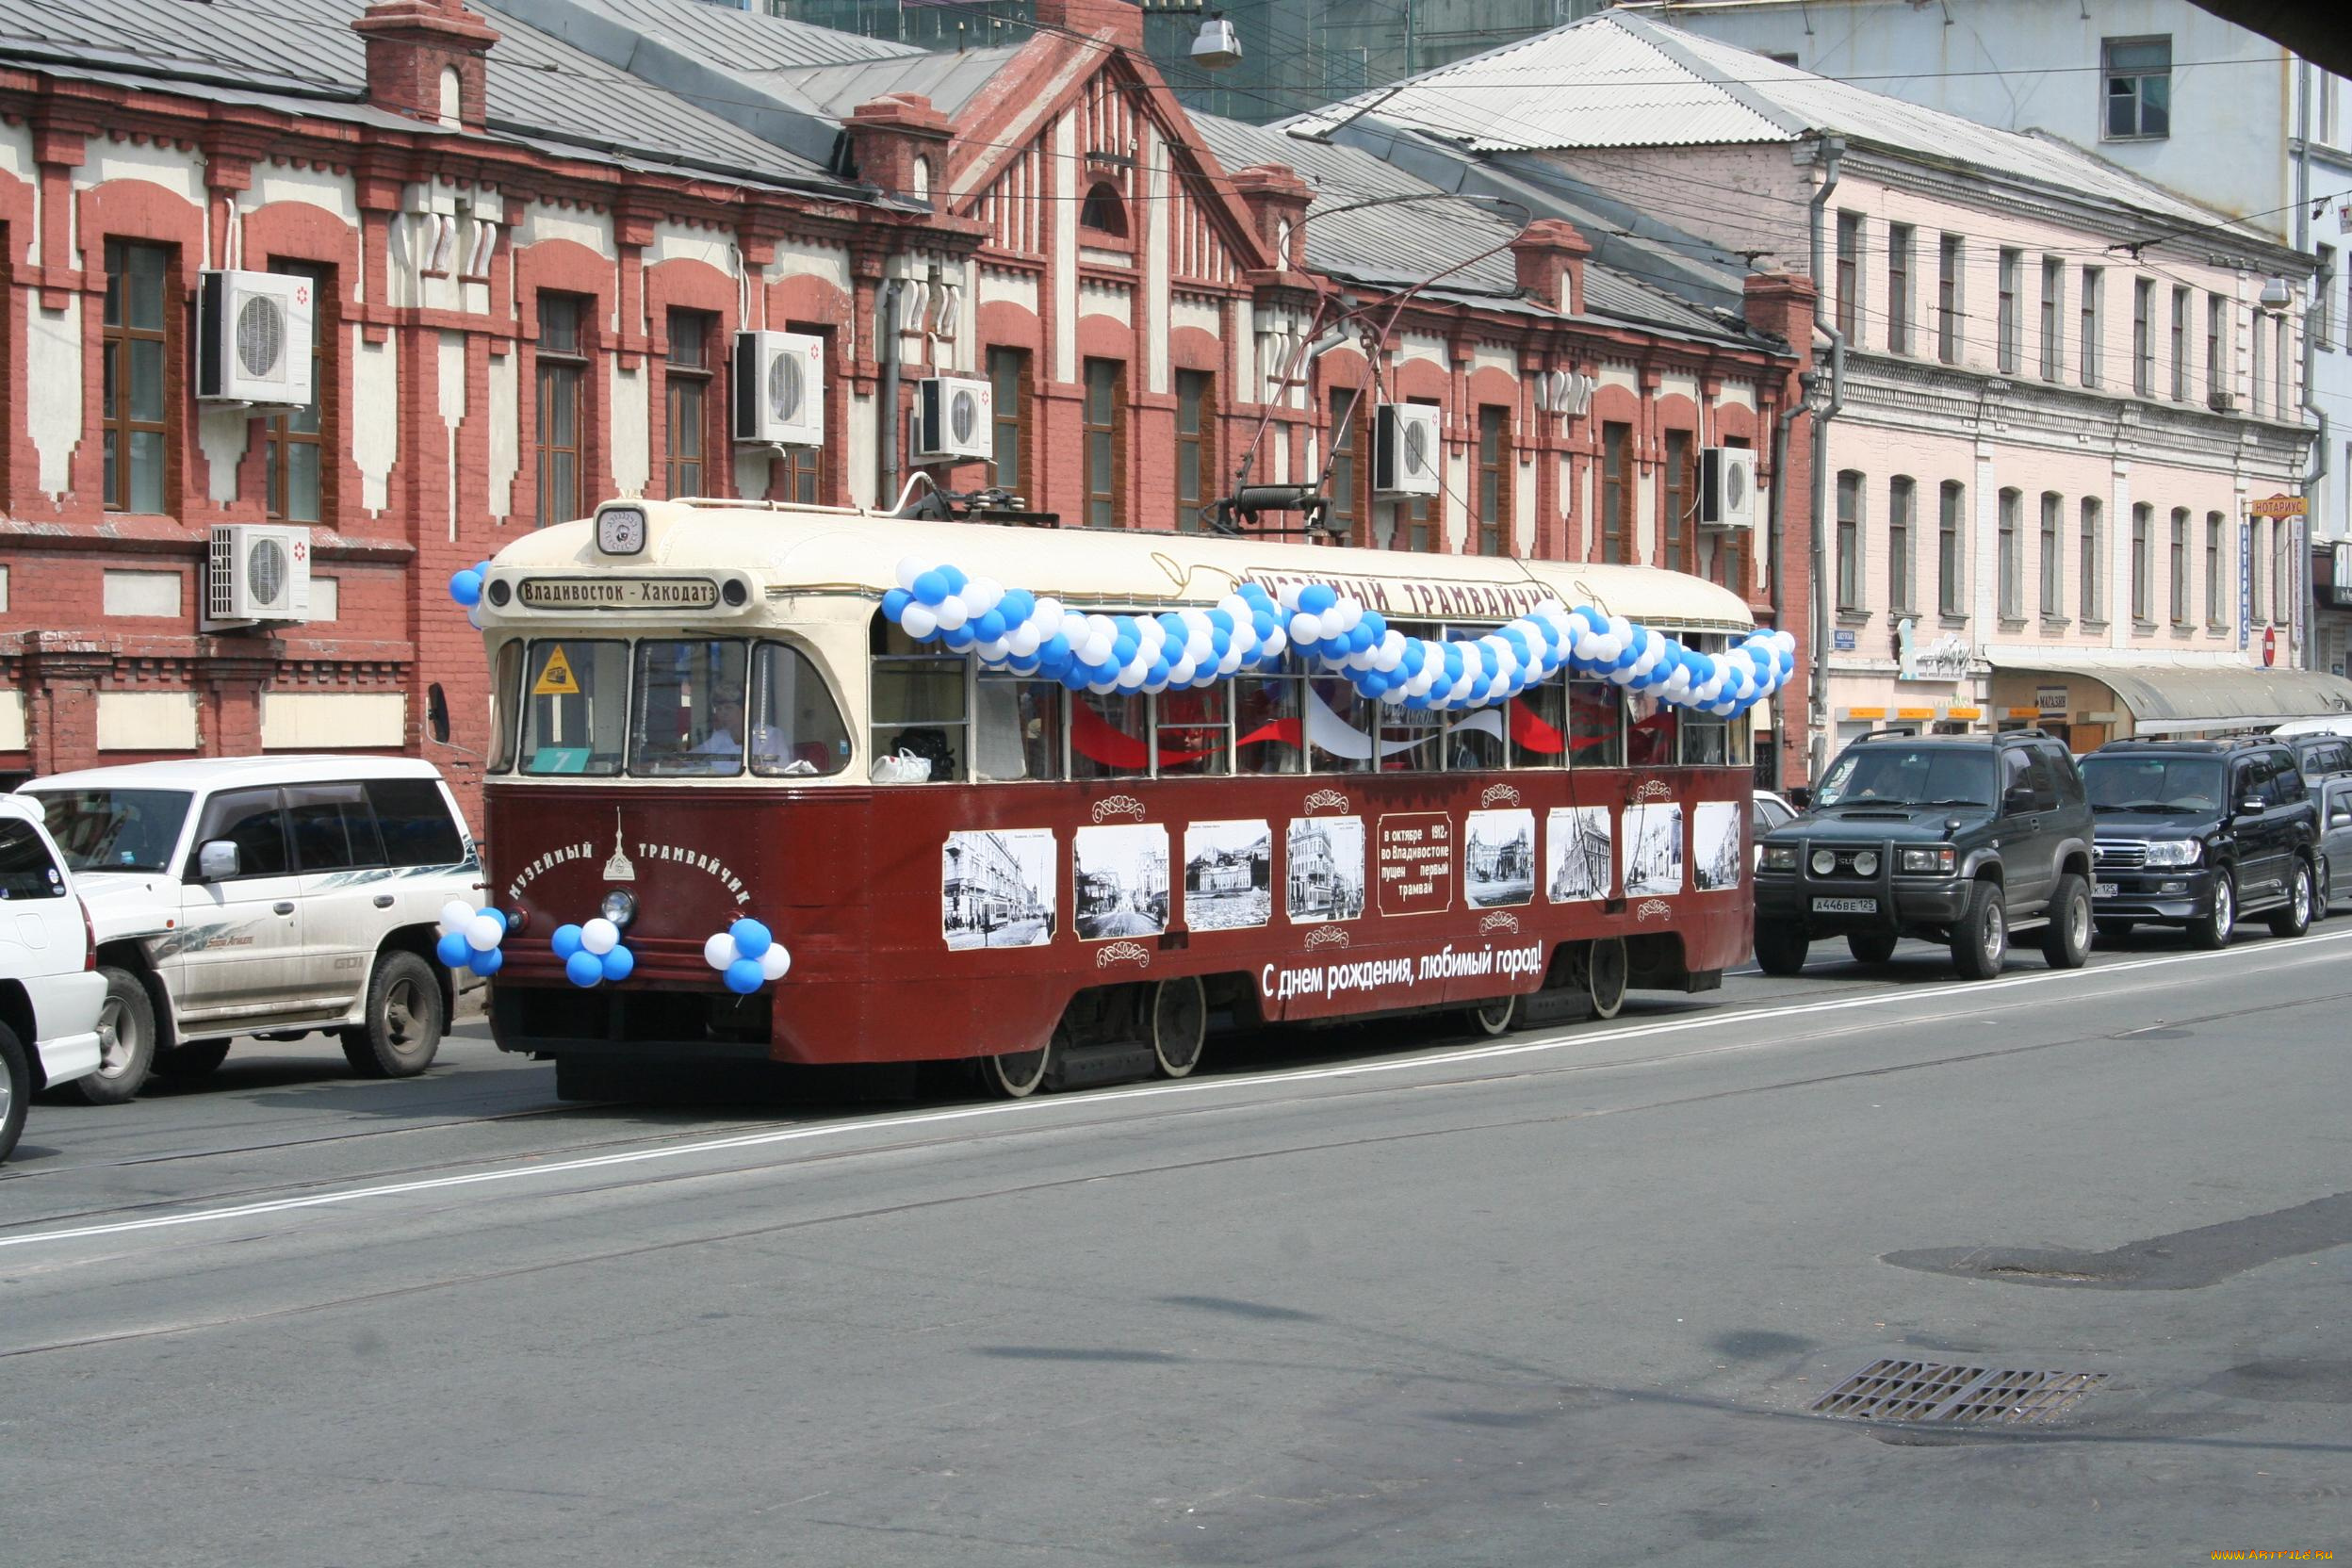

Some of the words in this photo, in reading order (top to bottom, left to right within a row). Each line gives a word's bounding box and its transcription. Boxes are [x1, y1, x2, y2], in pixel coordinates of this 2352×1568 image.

[2256, 501, 2302, 514] НОТАРИУС
[524, 582, 624, 601] Владивосток
[641, 585, 716, 602] Хакодатэ
[1384, 830, 1390, 842] в
[1392, 828, 1423, 845] октябре
[1380, 848, 1392, 860] во
[1392, 844, 1449, 862] Владивостоке
[508, 841, 593, 901] МУЗЕЙНЫЙ
[638, 842, 751, 906] ТРАМВАЙЧИК
[1381, 866, 1406, 883] пущен
[1420, 861, 1448, 880] первый
[1398, 881, 1433, 903] трамвай
[1859, 899, 1874, 909] 125
[334, 956, 364, 970] GDI
[1263, 963, 1274, 997] С
[1278, 968, 1323, 1001] днем
[1327, 957, 1414, 999] рождения,
[1418, 943, 1492, 980] любимый
[1495, 939, 1543, 980] город!
